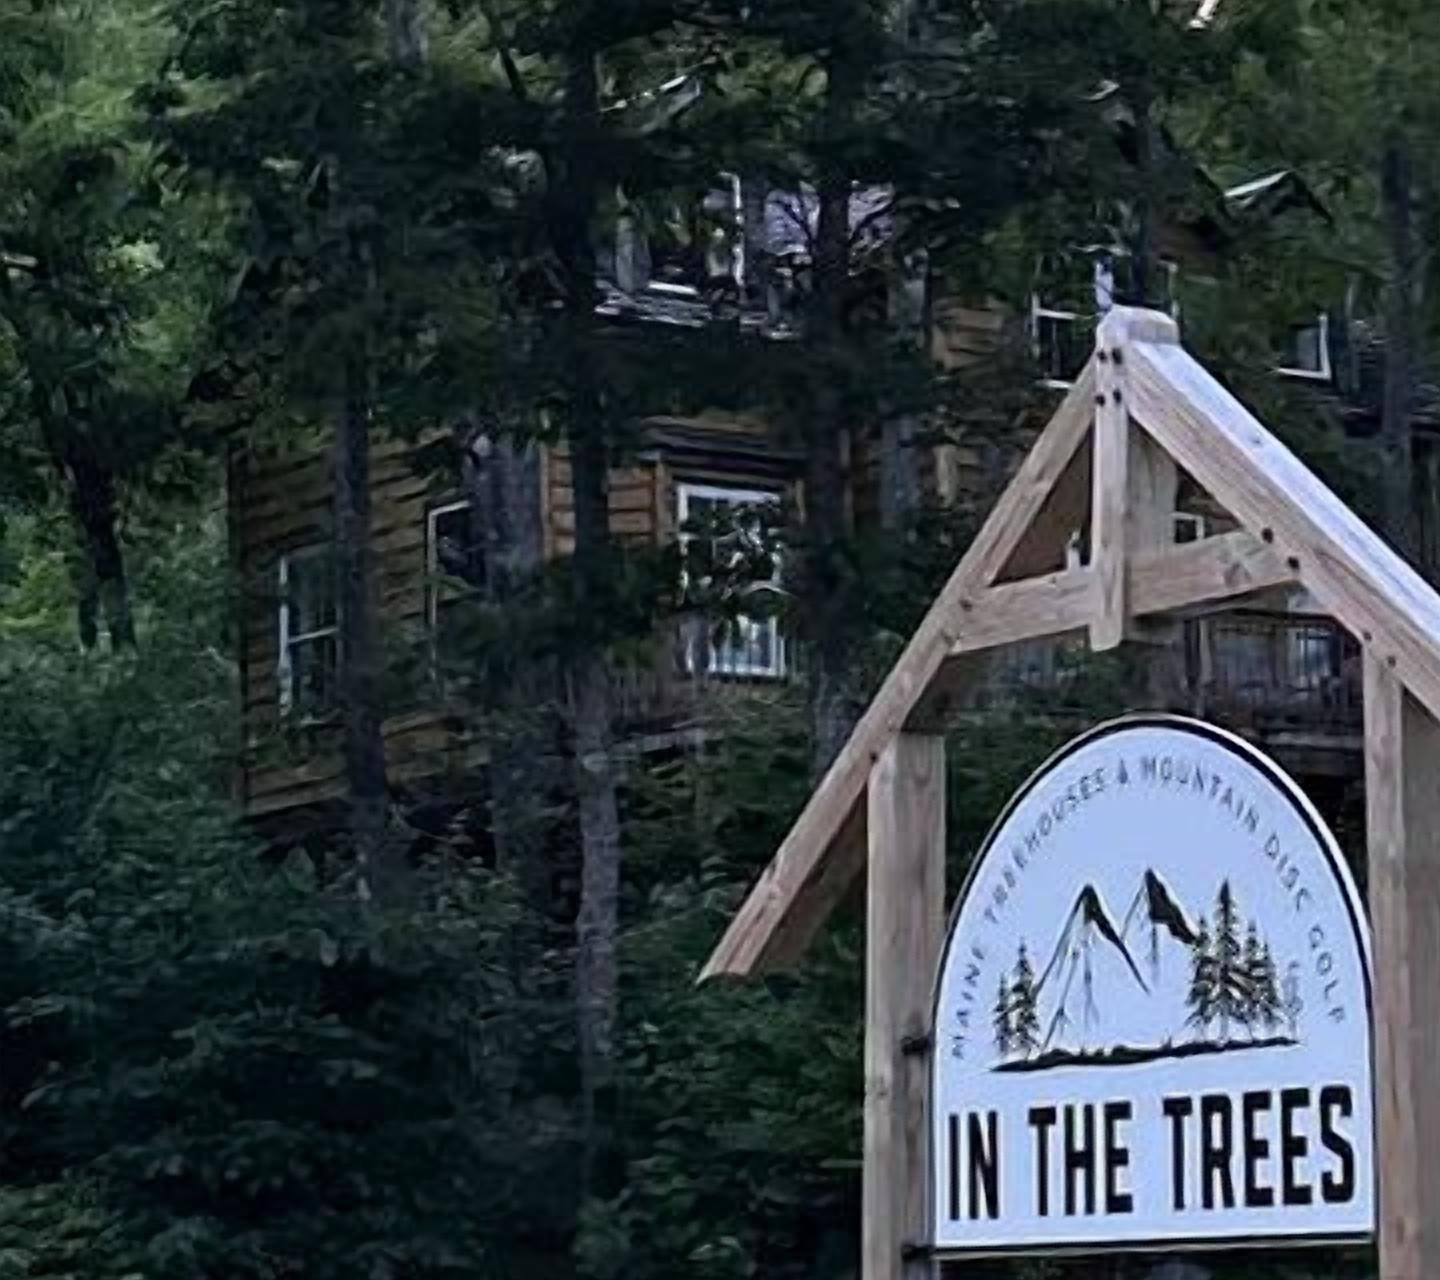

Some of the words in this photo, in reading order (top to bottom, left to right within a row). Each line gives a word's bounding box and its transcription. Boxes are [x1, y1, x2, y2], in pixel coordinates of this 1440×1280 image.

[951, 945, 987, 1059] MAINE
[1139, 757, 1260, 834] MOUNTAIN
[1264, 833, 1313, 913] DISC
[1308, 926, 1345, 1025] GOLF
[948, 1110, 1000, 1220] IN
[1028, 1102, 1133, 1216] THE
[1163, 1085, 1356, 1211] TREES
